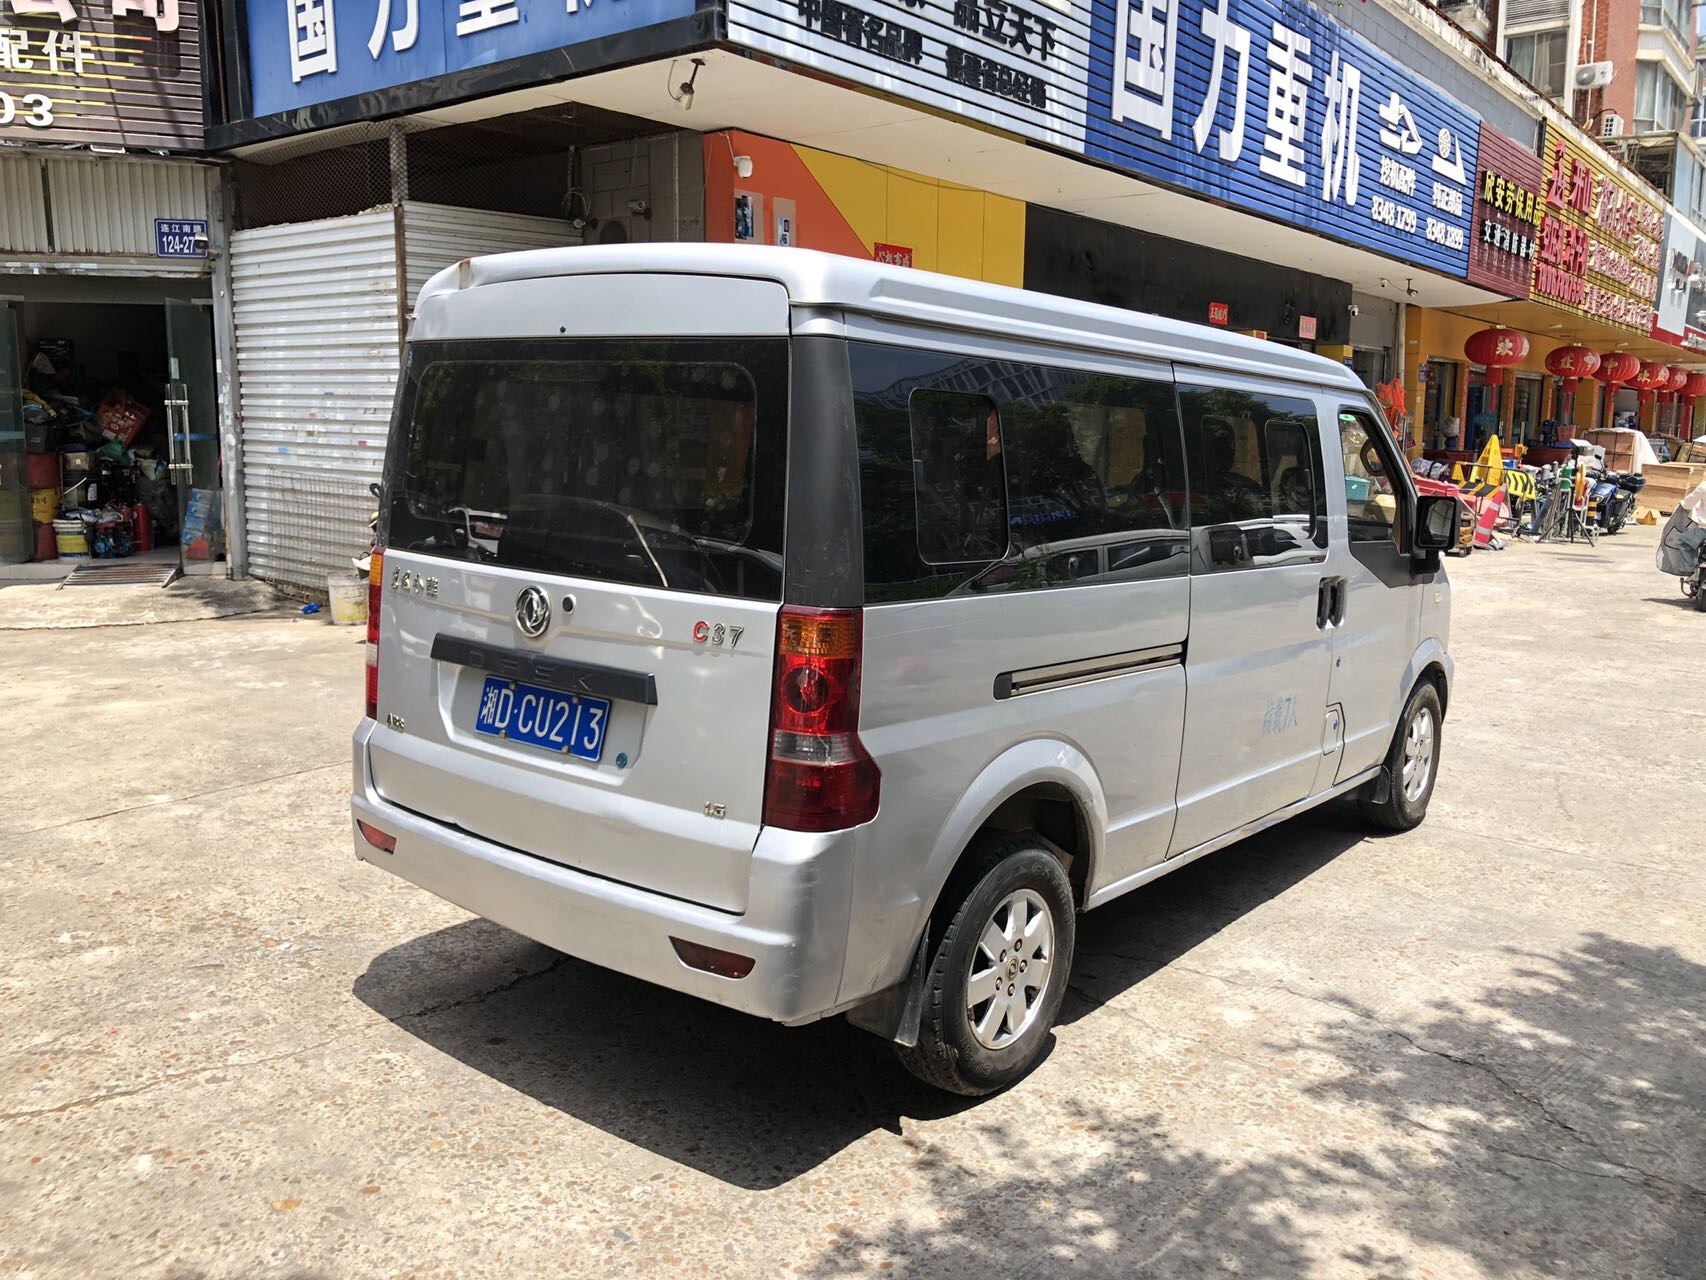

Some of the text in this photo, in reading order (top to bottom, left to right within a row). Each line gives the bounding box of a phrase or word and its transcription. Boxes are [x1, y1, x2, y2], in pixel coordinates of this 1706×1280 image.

[1112, 0, 1361, 207] 国力重机
[693, 620, 744, 648] C37
